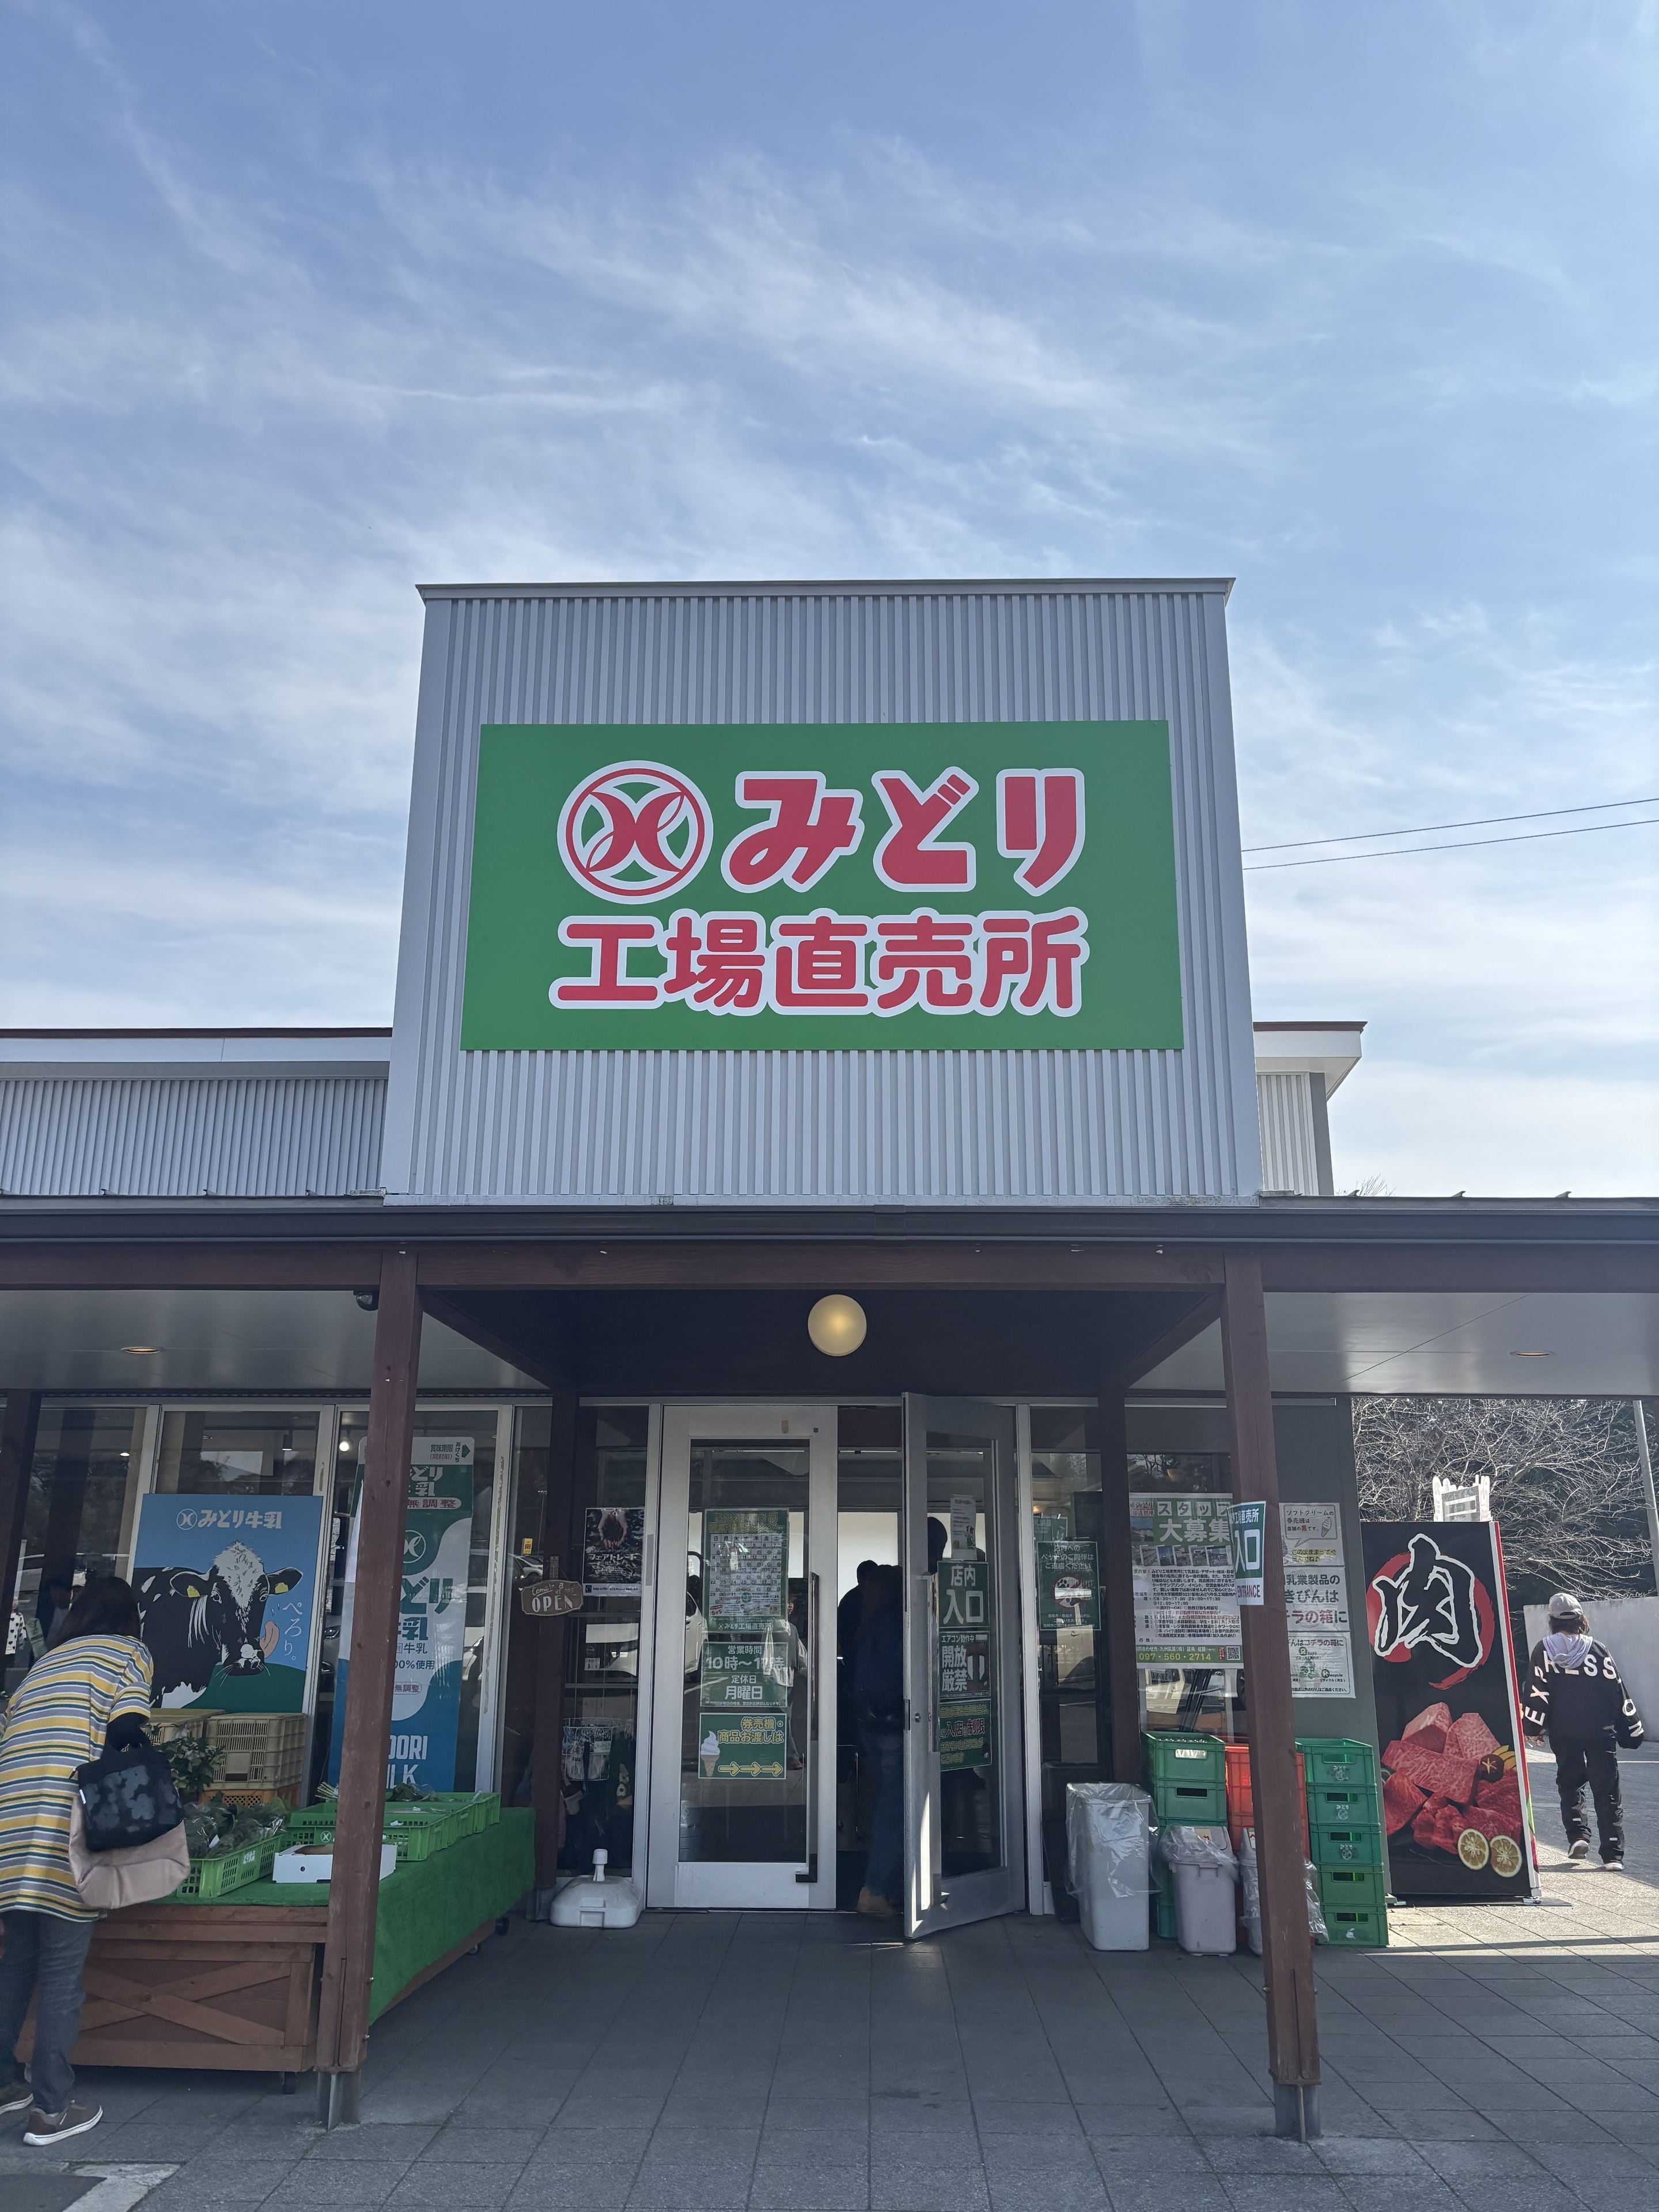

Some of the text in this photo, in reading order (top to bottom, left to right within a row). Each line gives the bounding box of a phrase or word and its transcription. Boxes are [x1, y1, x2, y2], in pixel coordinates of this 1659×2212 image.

[723, 768, 1084, 893] みどり
[551, 909, 1087, 1014] 工場直売所
[430, 1444, 453, 1452] 賞味期限
[408, 1482, 435, 1497] 乳
[198, 1509, 282, 1529] みどり牛乳
[1158, 1502, 1232, 1516] スタッフ
[1159, 1518, 1232, 1543] 大募集
[1234, 1528, 1260, 1573] 入口
[951, 1565, 976, 1586] 店内
[1285, 1574, 1340, 1585] 乳業製品の
[1237, 1585, 1260, 1598] ENTRANCE
[1372, 1533, 1483, 1668] 肉
[532, 1594, 573, 1612] OPEN
[943, 1589, 984, 1624] 入口
[283, 1602, 303, 1660] ぺろり。
[397, 1617, 429, 1641] 乳
[728, 1645, 762, 1654] 営業時間
[1289, 1638, 1344, 1646] んはコチラの箱に
[942, 1645, 967, 1668] 開放
[731, 1675, 757, 1684] 定休日
[942, 1669, 968, 1692] 厳禁
[725, 1685, 763, 1700] 月曜日
[718, 1729, 785, 1744] 商品お渡しは
